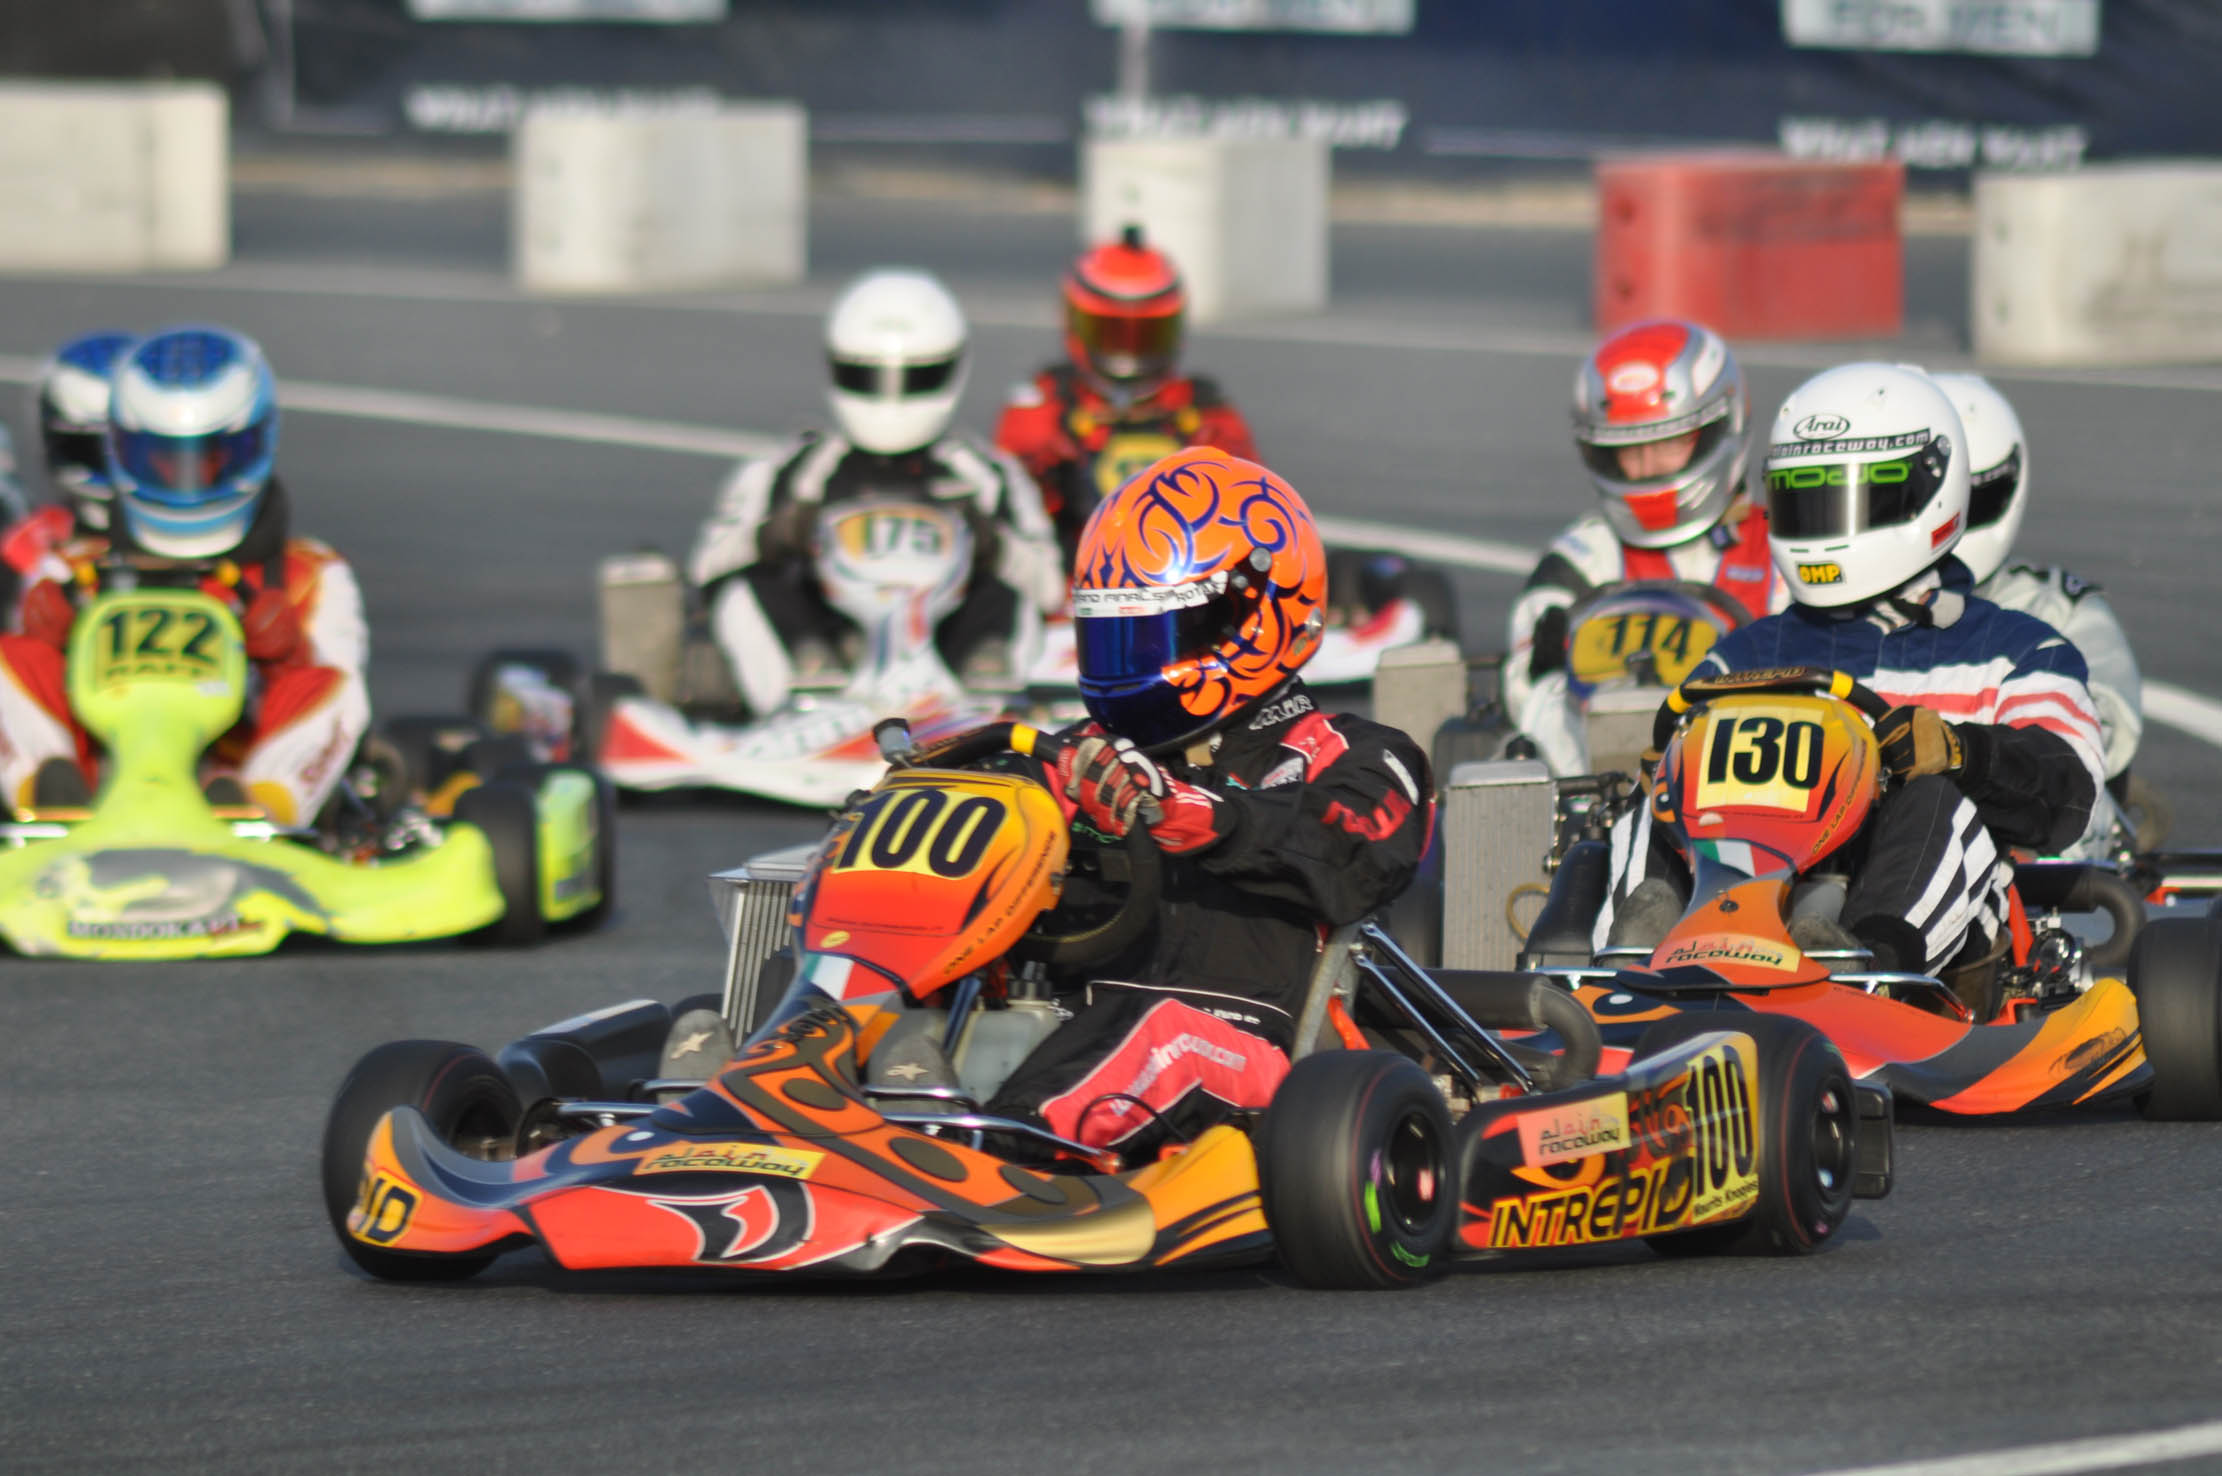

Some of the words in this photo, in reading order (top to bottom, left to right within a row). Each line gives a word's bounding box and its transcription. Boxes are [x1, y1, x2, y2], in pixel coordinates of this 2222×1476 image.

[1803, 413, 1844, 432] Arai
[102, 608, 220, 663] 122
[1606, 612, 1692, 665] 114
[1707, 716, 1825, 789] 130
[837, 788, 1007, 879] 100
[1685, 1044, 1754, 1198] 100
[1489, 1153, 1695, 1248] INTREPID
